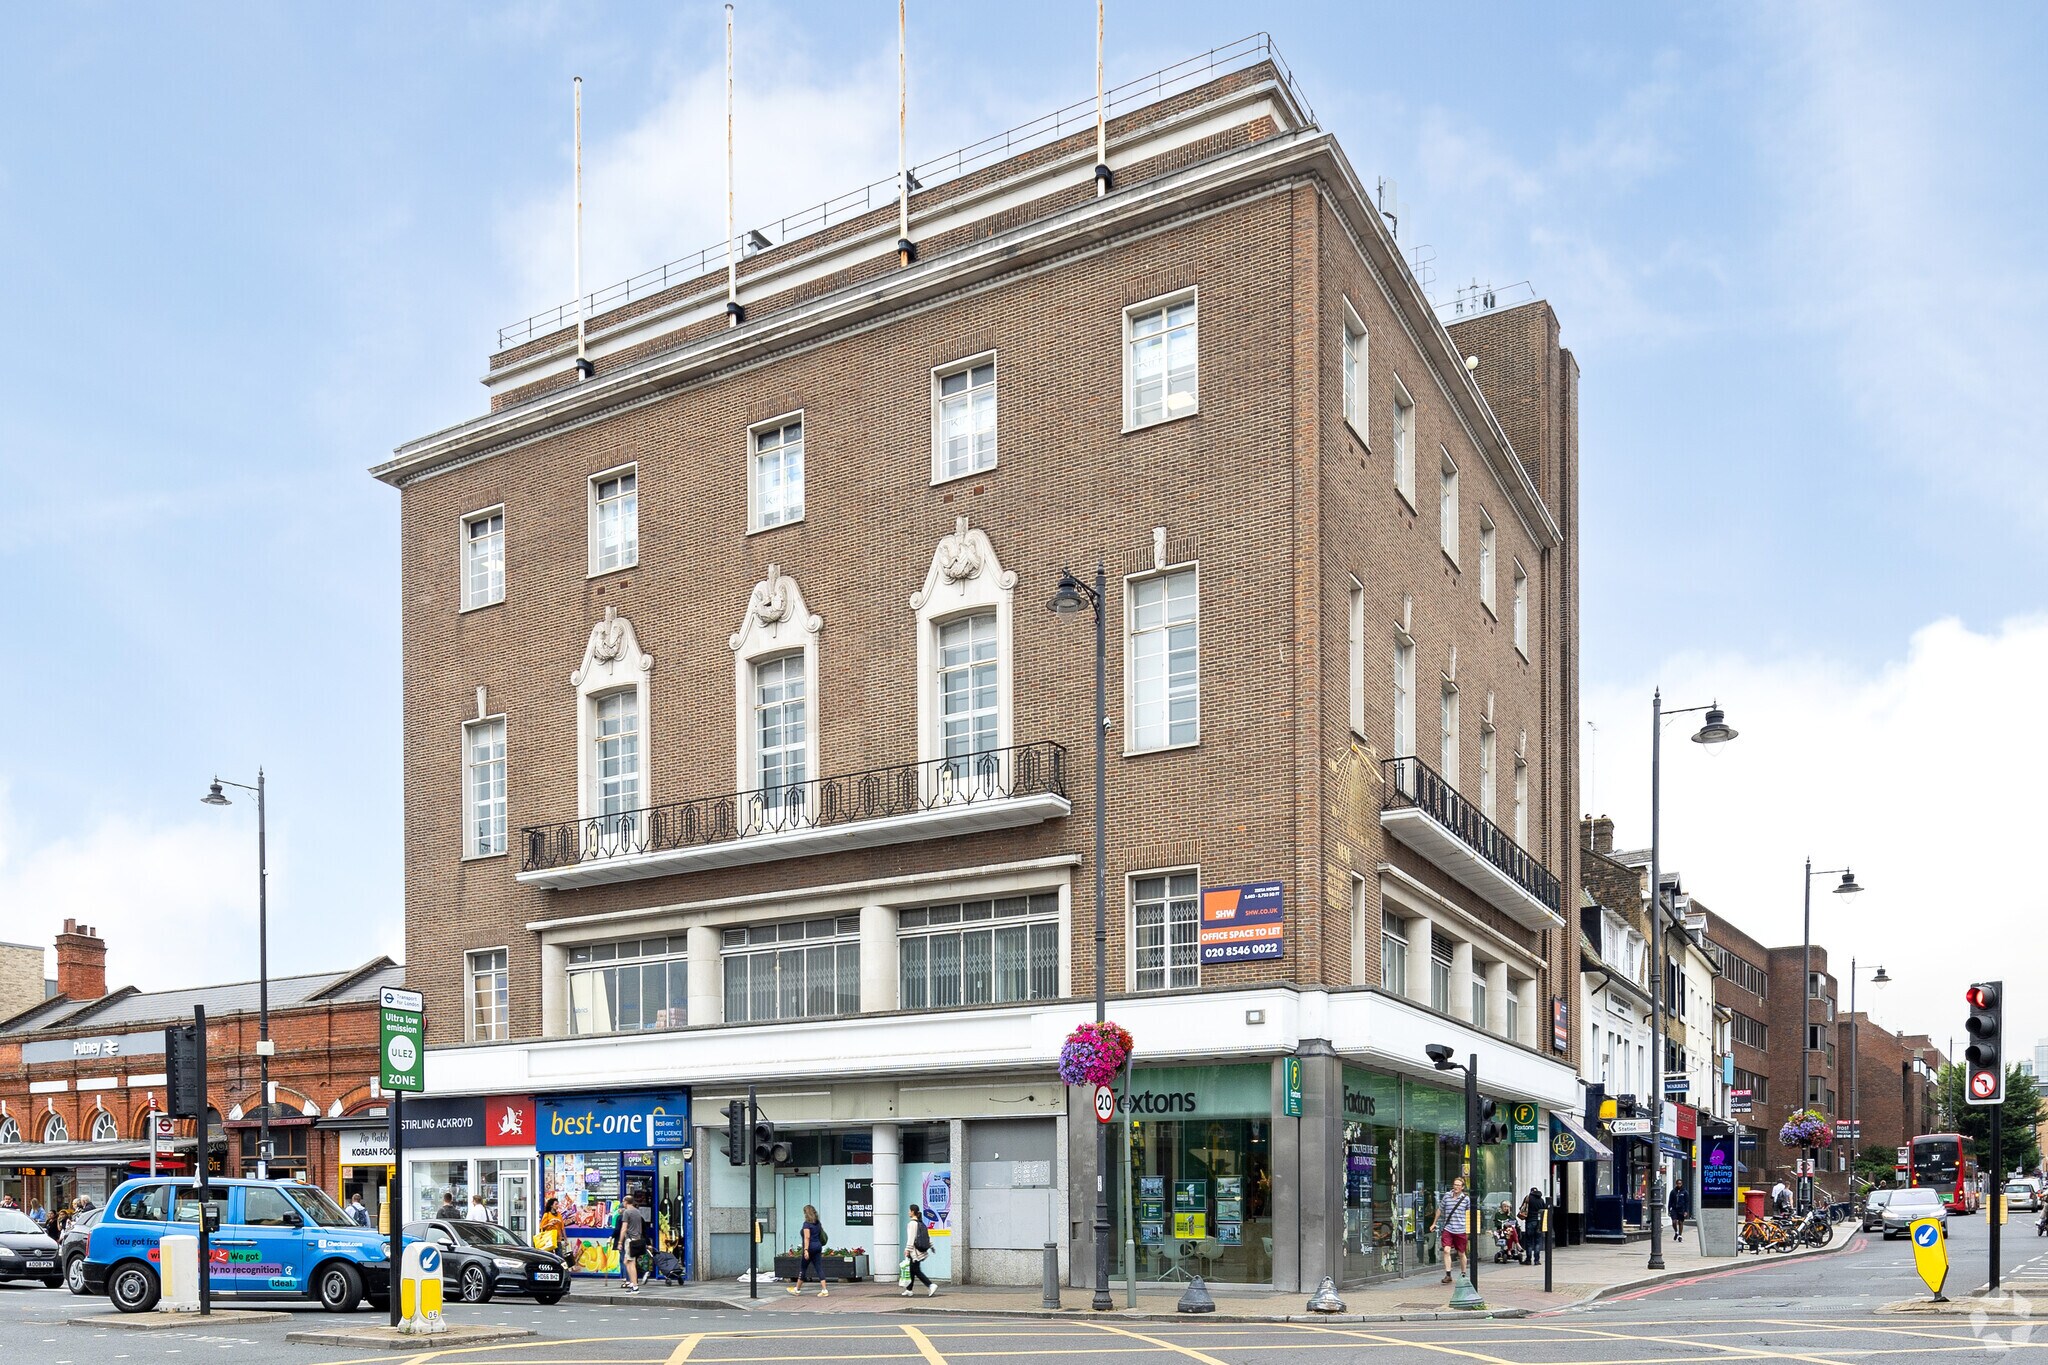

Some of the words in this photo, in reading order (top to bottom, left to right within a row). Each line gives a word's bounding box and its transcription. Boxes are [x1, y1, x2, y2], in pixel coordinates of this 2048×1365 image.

[1216, 910, 1236, 918] SHW
[1245, 908, 1278, 916] SHW.CO.UK
[1202, 932, 1228, 940] OFFICE
[1229, 930, 1254, 938] SPACE
[1268, 927, 1281, 935] LET
[1206, 948, 1224, 958] 020
[1226, 946, 1250, 956] 8546
[1252, 944, 1277, 954] 0022
[386, 1013, 404, 1022] Ultra
[406, 1016, 418, 1024] low
[386, 1024, 417, 1033] emission
[73, 1042, 102, 1056] Putney
[392, 1049, 413, 1058] ULEZ
[389, 1074, 416, 1085] ZONE
[150, 1099, 156, 1107] E
[1098, 1095, 1112, 1110] 20
[1344, 1085, 1376, 1116] Foxtons
[1521, 1108, 1528, 1120] F
[402, 1119, 434, 1130] STIRLING
[436, 1117, 473, 1128] ACKROYD
[552, 1111, 642, 1136] best-one
[352, 1148, 378, 1156] KOREAN
[132, 1239, 145, 1248] got
[146, 1237, 160, 1245] fro
[230, 1252, 243, 1260] We
[246, 1253, 259, 1261] got
[232, 1265, 282, 1275] recognition.
